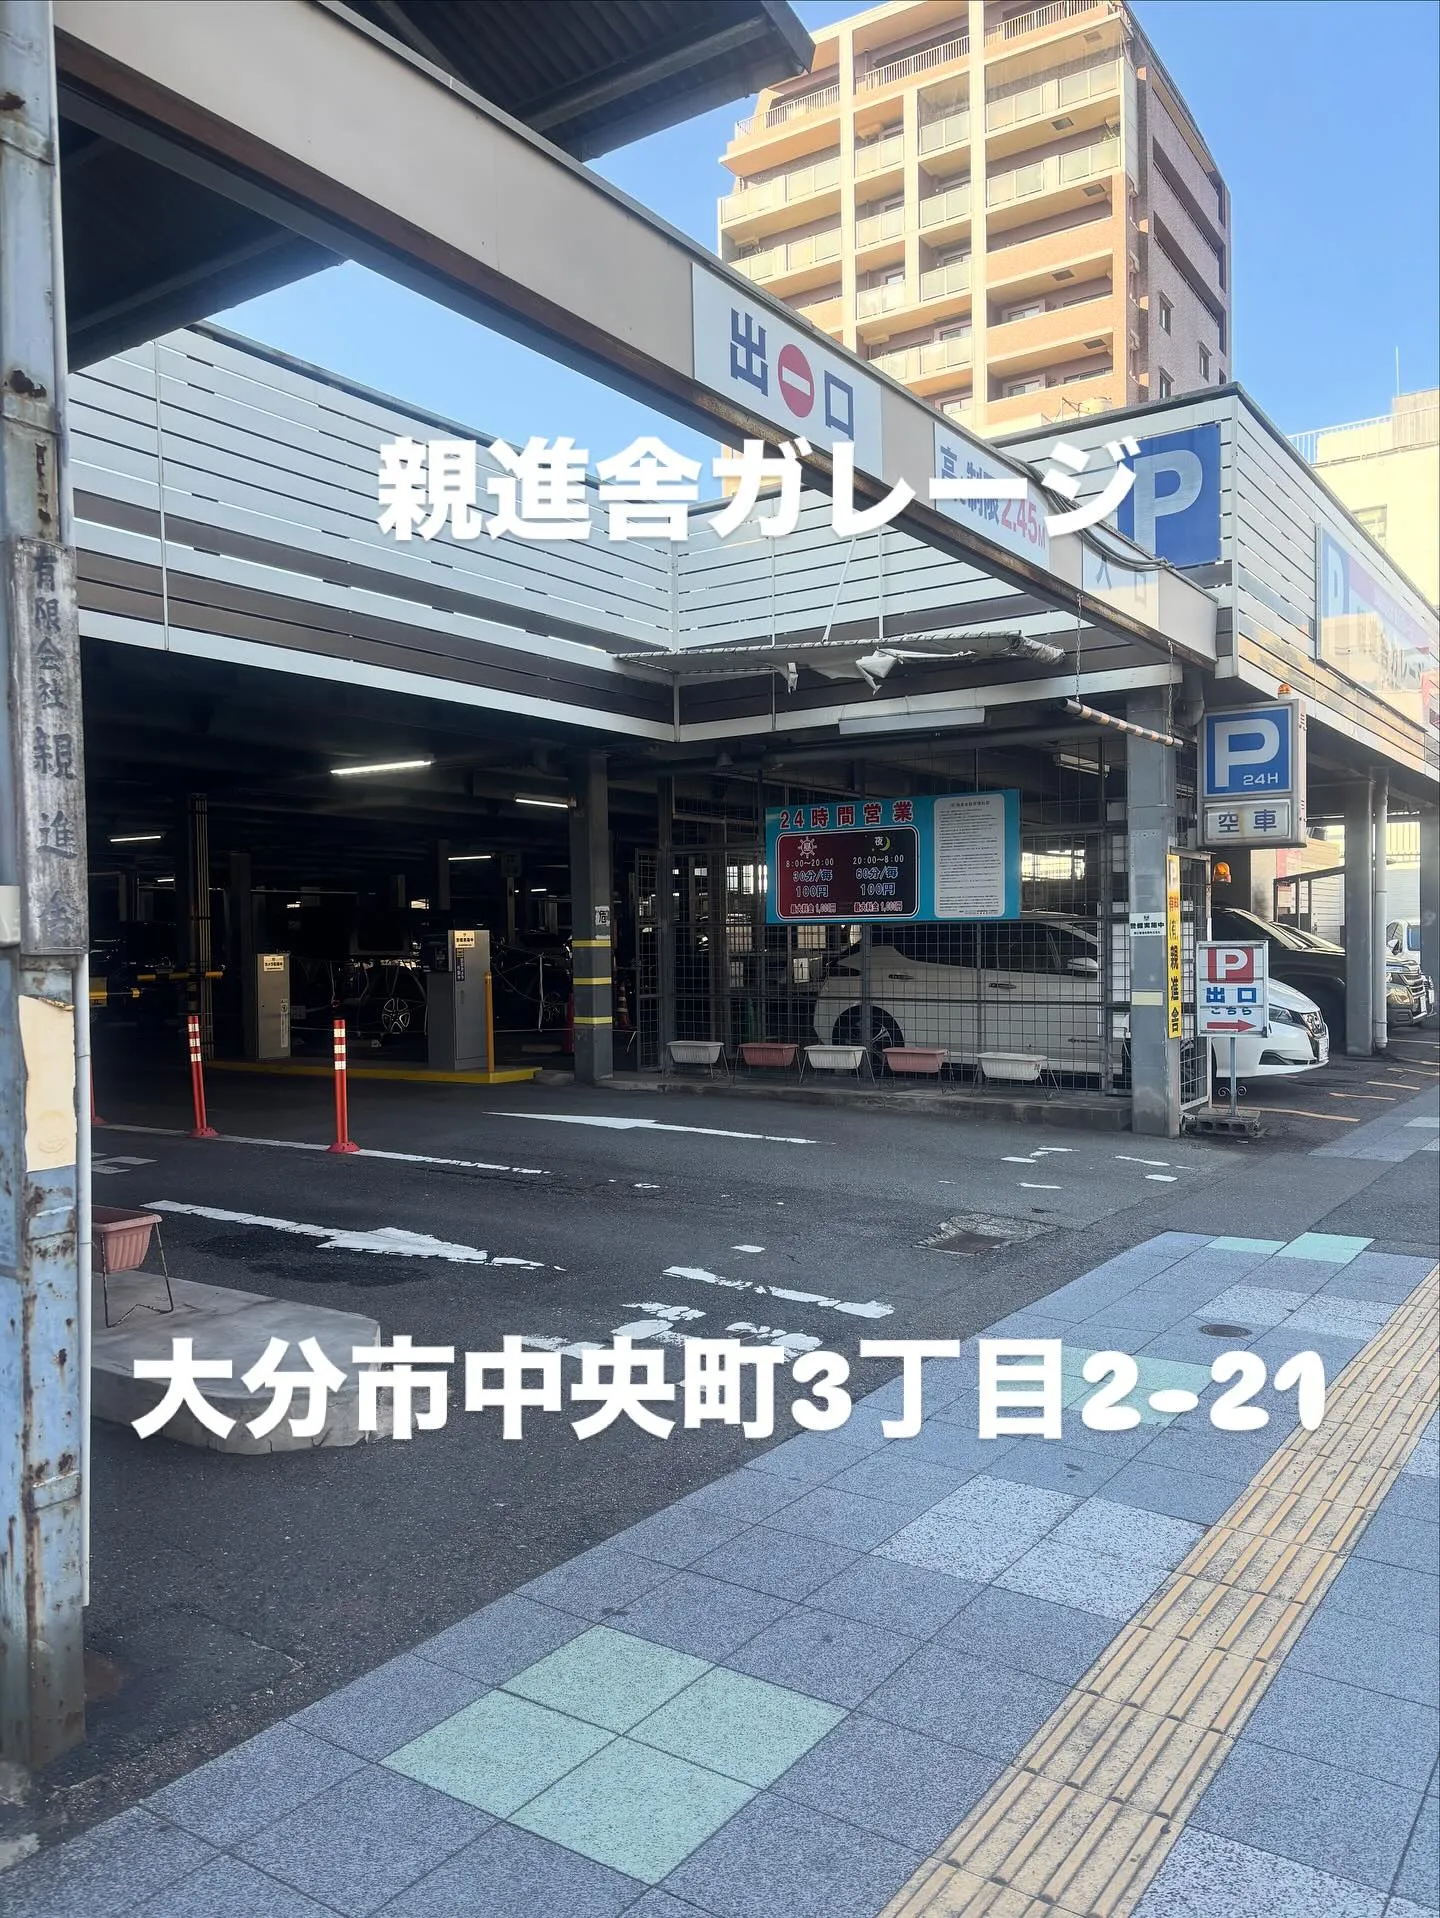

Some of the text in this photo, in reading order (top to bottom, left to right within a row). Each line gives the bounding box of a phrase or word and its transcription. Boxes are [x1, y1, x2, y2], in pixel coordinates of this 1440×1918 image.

[730, 307, 854, 440] 出口
[1134, 449, 1203, 556] P
[1214, 718, 1280, 788] P
[1243, 772, 1279, 786] 24H
[780, 800, 914, 830] 24時間営業
[1218, 809, 1277, 833] 空車
[795, 884, 829, 898] 100円
[860, 882, 896, 896] 100円
[1216, 948, 1248, 979] P
[1206, 987, 1257, 1003] 出口
